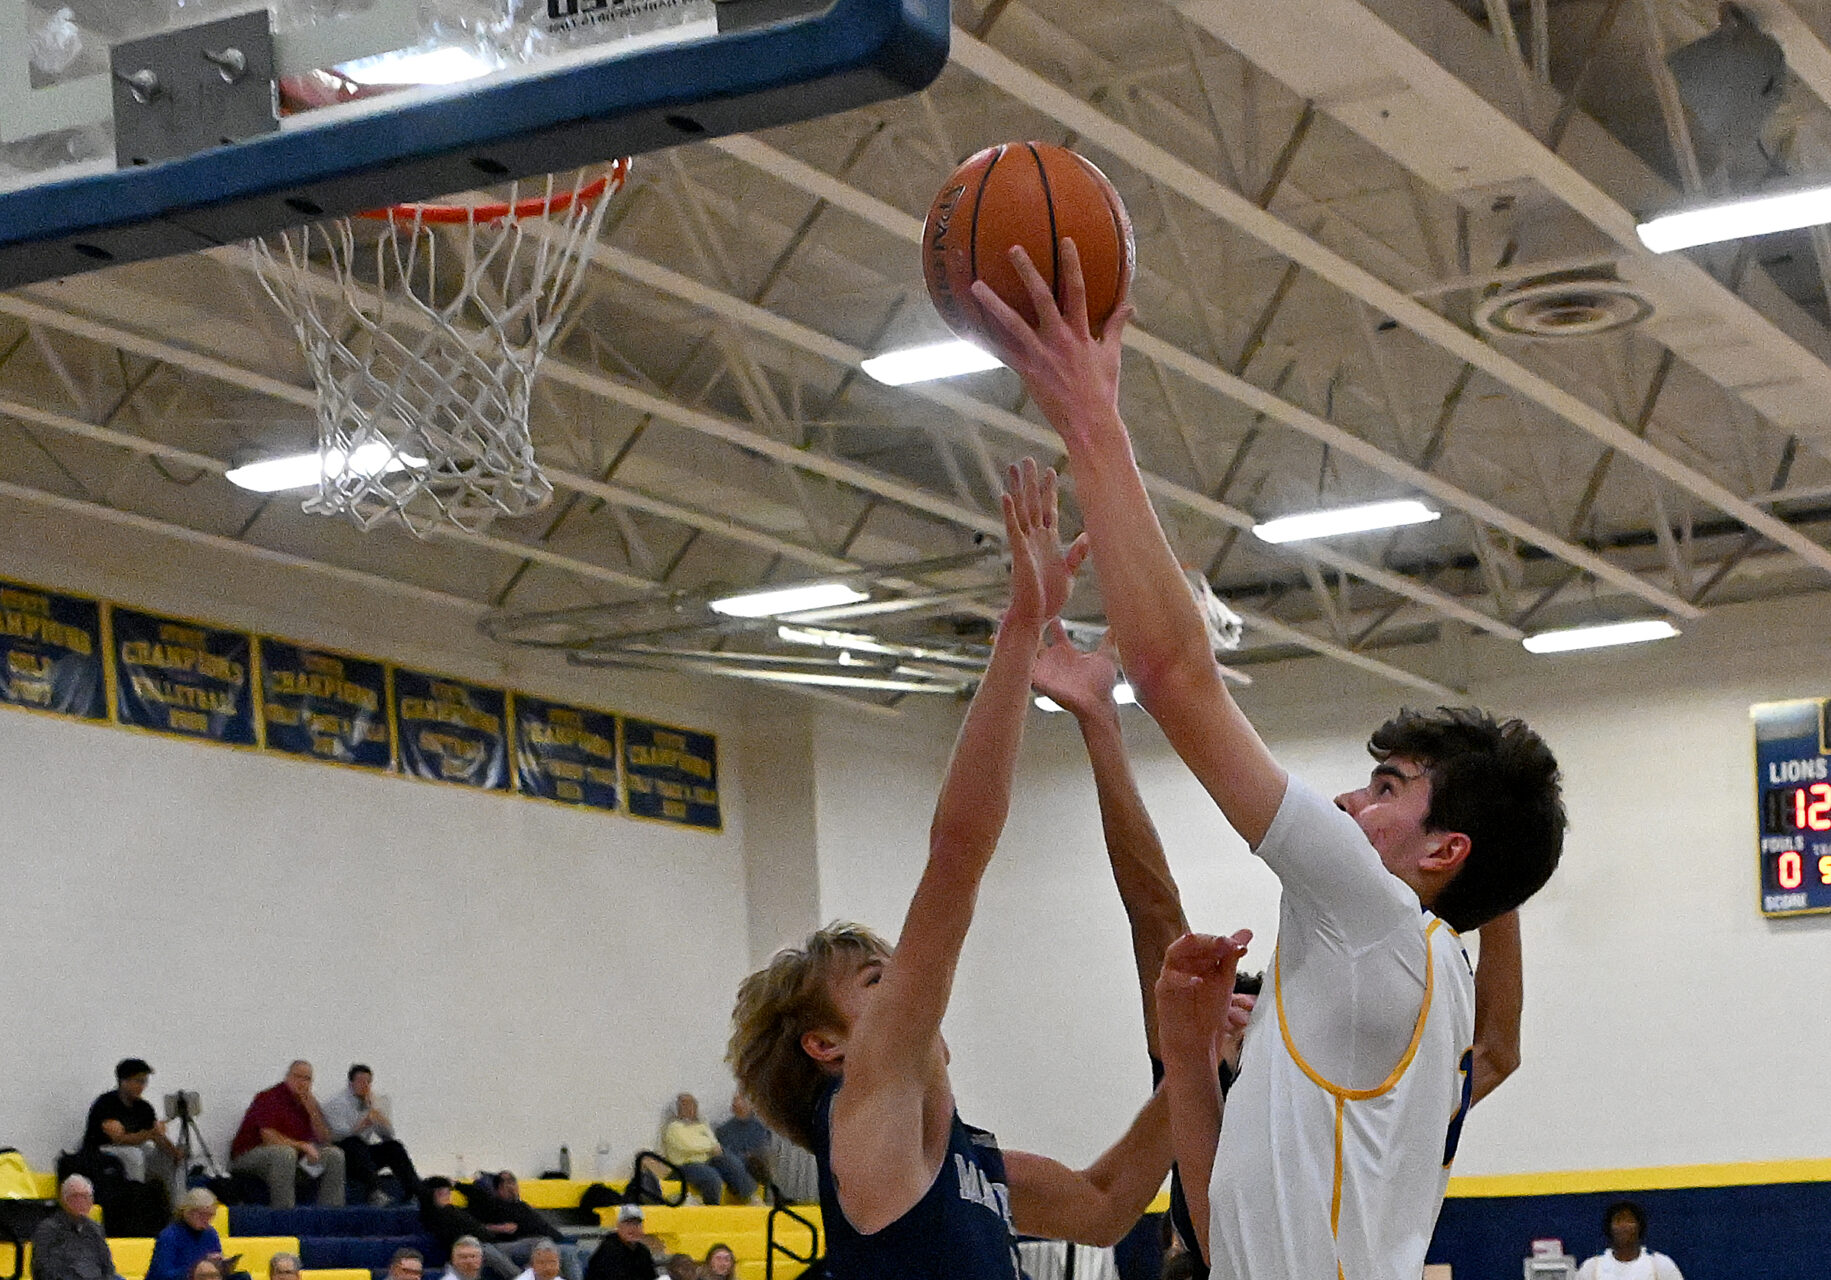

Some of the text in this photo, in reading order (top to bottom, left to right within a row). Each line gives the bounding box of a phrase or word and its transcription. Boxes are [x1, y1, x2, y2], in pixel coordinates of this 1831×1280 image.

[1769, 758, 1828, 784] LIONS
[1795, 783, 1831, 831] 12
[1778, 851, 1803, 889] 0
